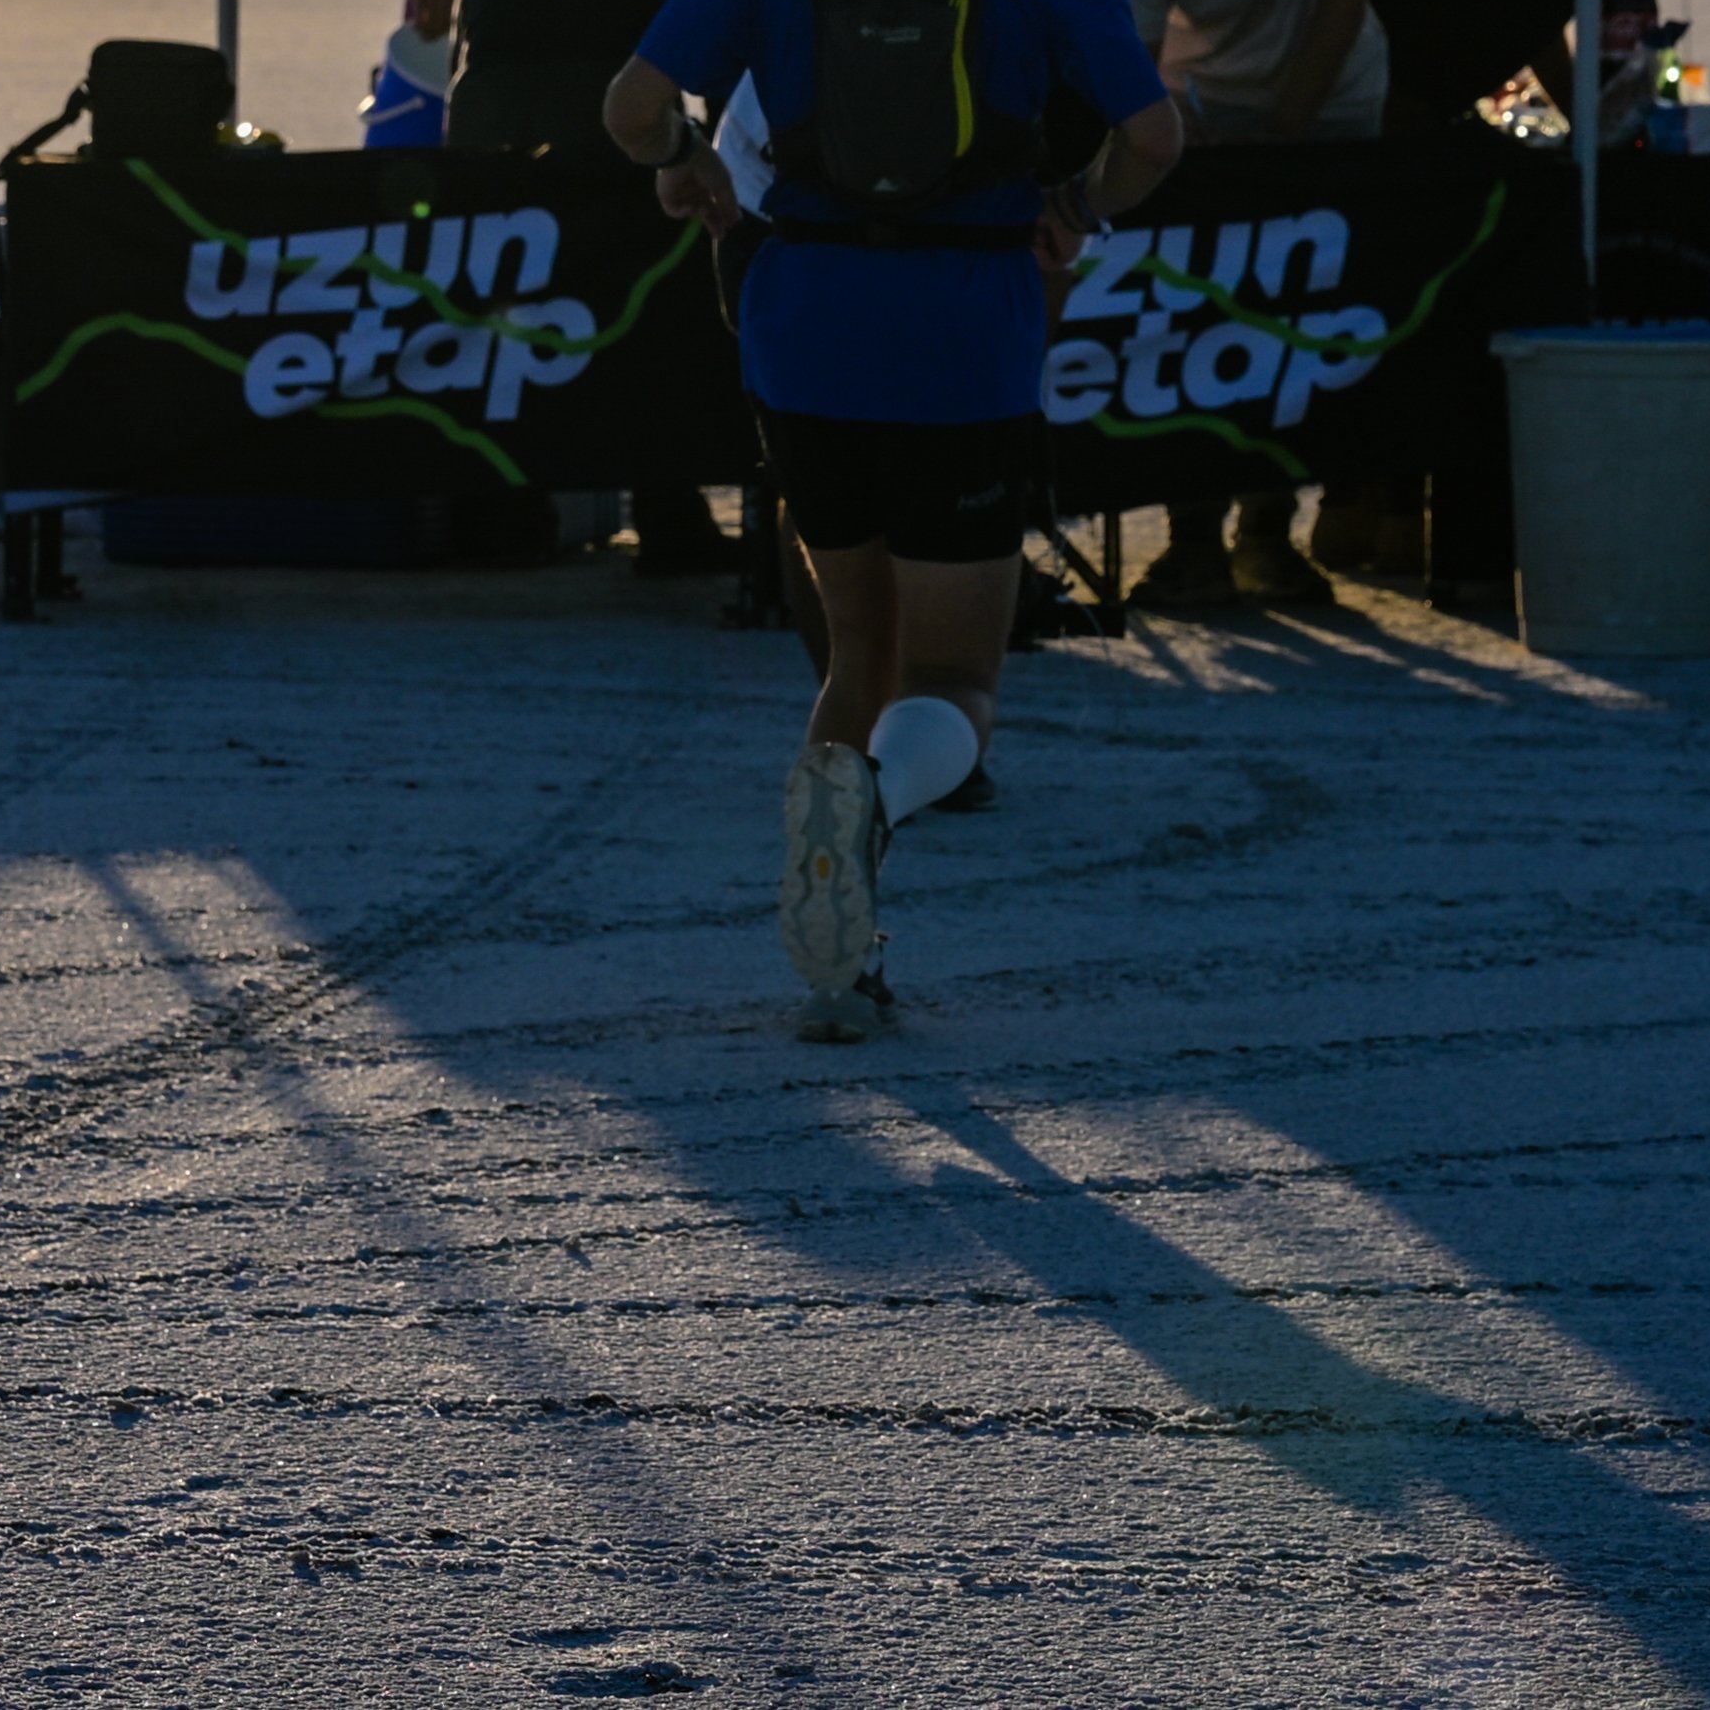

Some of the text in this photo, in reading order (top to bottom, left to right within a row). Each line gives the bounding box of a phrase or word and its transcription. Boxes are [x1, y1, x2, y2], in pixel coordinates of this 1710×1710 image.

[185, 207, 560, 320] uzun
[1060, 208, 1351, 322] zun
[244, 297, 597, 420] etap
[1039, 304, 1388, 429] etap
